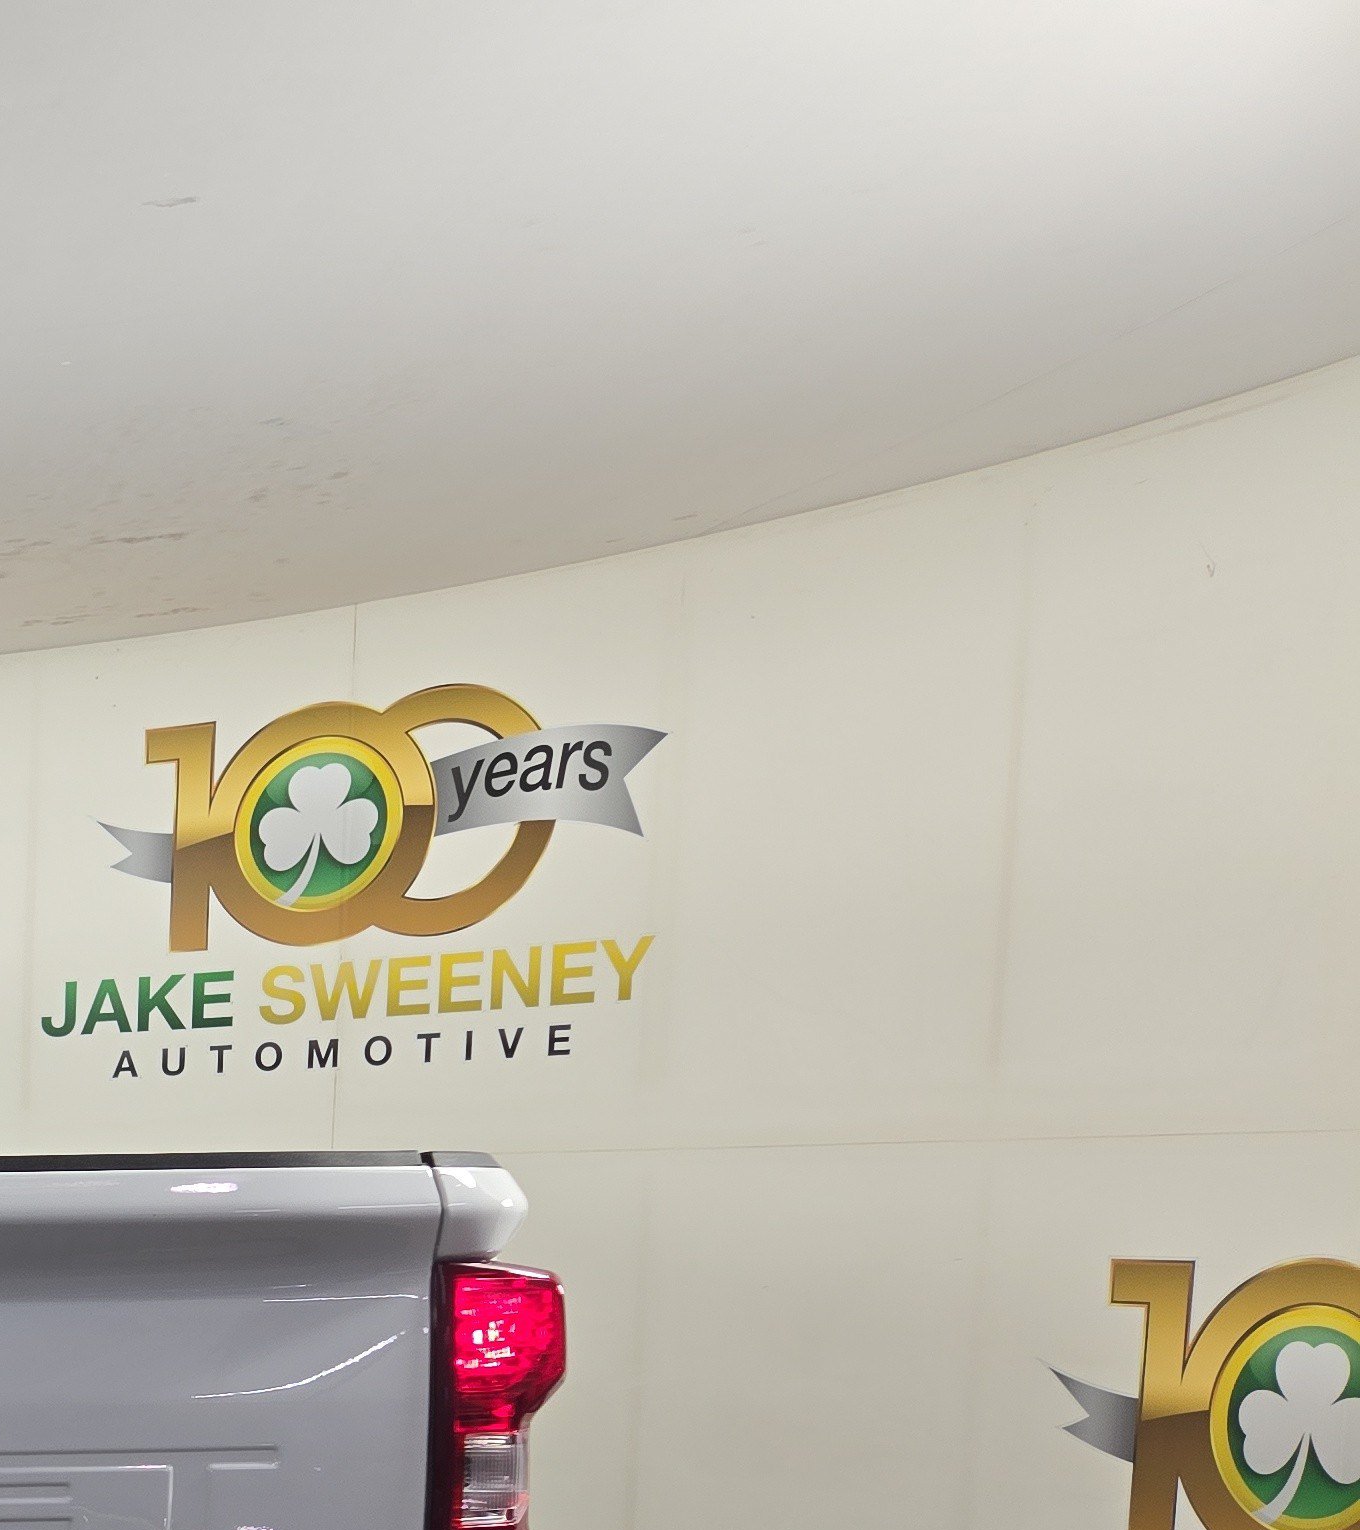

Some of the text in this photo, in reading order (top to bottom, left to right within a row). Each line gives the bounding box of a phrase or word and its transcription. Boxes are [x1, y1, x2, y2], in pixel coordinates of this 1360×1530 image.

[144, 682, 558, 953] 100
[446, 737, 613, 823] years
[40, 934, 657, 1038] JAKE SWEENEY
[111, 1022, 574, 1079] AUTOMOTIVE
